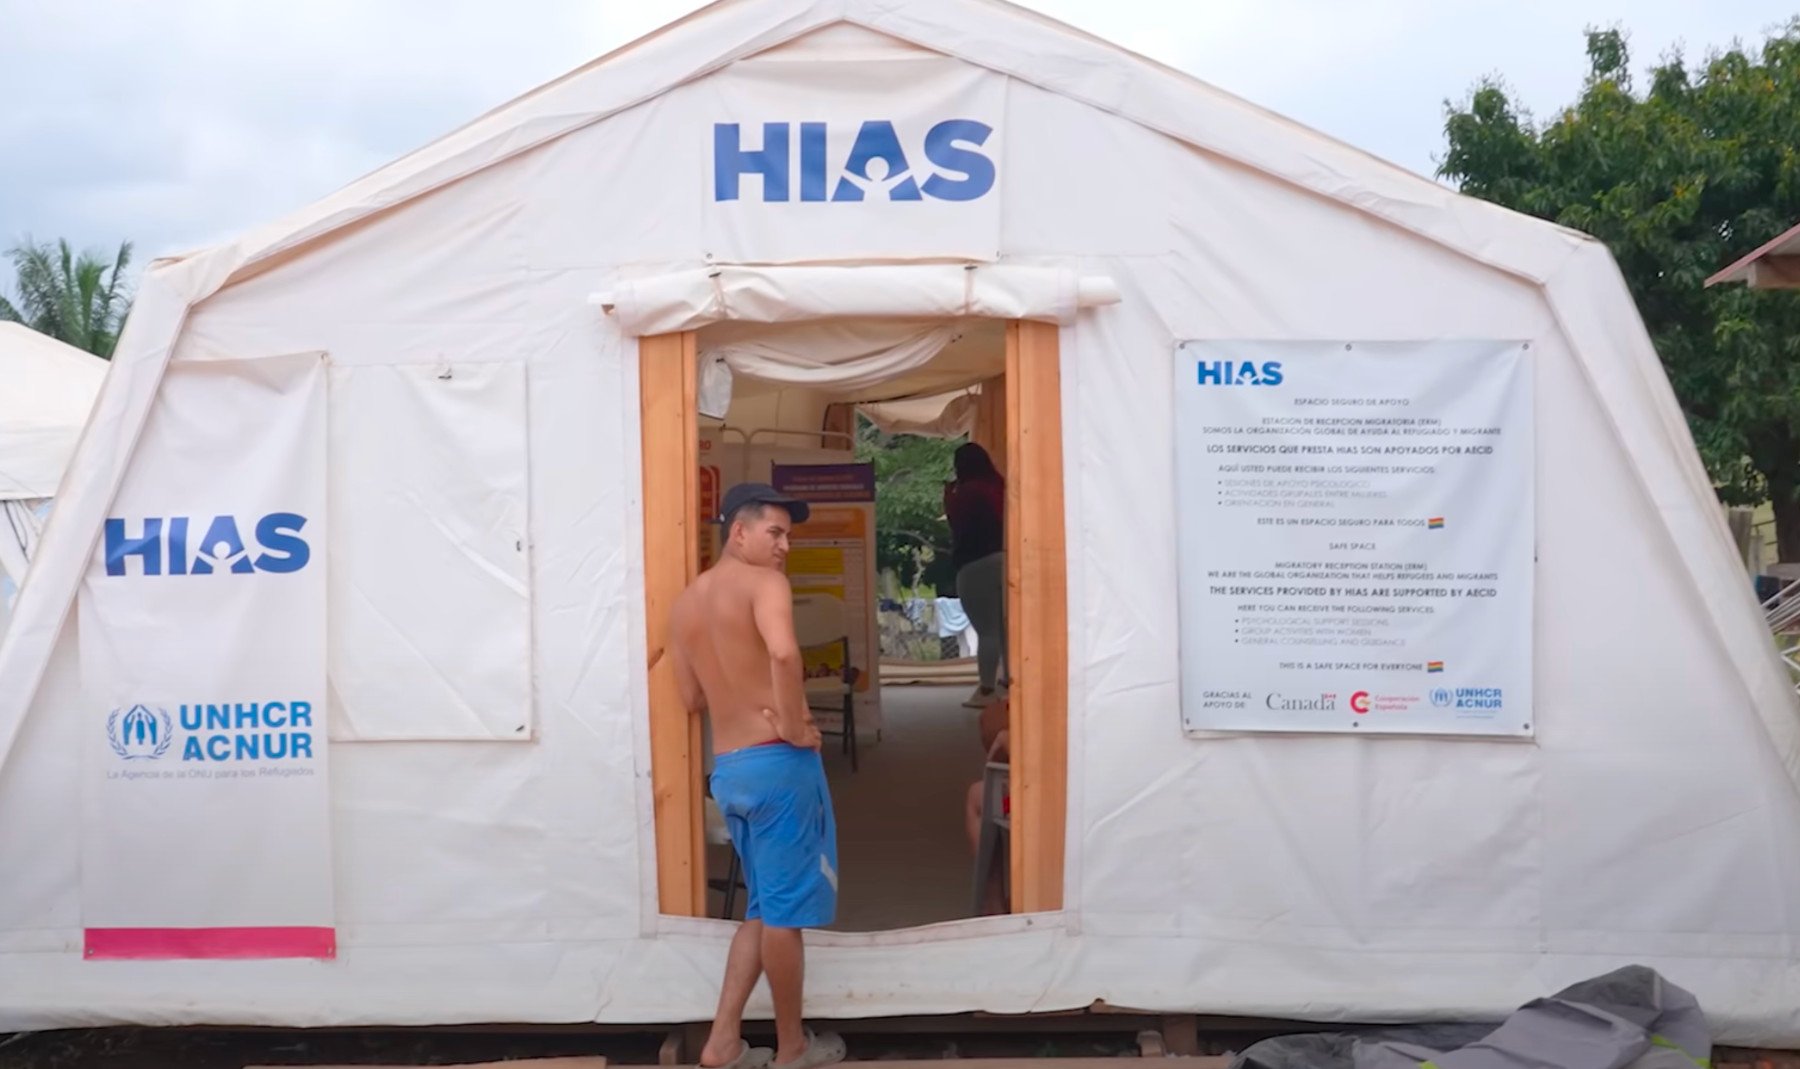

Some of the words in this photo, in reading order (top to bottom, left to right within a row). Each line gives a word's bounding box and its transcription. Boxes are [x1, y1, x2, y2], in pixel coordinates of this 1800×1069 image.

[714, 119, 996, 203] HIAS
[1198, 361, 1283, 386] HIAS
[1294, 398, 1329, 406] ESPACIO
[1331, 398, 1364, 406] SEGURO
[1366, 398, 1376, 406] DE
[1379, 398, 1410, 406] APOYO
[1303, 417, 1314, 425] DE
[1365, 418, 1416, 426] MIGRATORIA
[1203, 426, 1232, 434] SOMOS
[1233, 426, 1243, 434] LA
[1360, 427, 1388, 435] AYUDA
[1391, 427, 1401, 435] AL
[1403, 427, 1450, 435] REFUGIADO
[1207, 445, 1224, 453] LOS
[1226, 445, 1276, 454] SERVICIOS
[1278, 445, 1298, 454] QUE
[1301, 445, 1333, 454] PRESTA
[1336, 445, 1358, 454] HIAS
[1361, 445, 1381, 454] SON
[1384, 446, 1439, 454] APOYADOS
[1441, 446, 1461, 454] POR
[1464, 446, 1493, 455] AECID
[1241, 465, 1265, 473] USTED
[1267, 465, 1292, 473] PUEDE
[1294, 465, 1325, 473] RECIBIR
[1257, 517, 1274, 525] ESTE
[1301, 518, 1336, 526] ESPACIO
[1338, 518, 1371, 526] SEGURO
[1372, 518, 1394, 526] PARA
[1397, 518, 1425, 526] TODOS
[104, 512, 311, 577] HIAS
[1275, 561, 1322, 569] MIGRATORY
[1324, 562, 1368, 570] RECEPTION
[1370, 562, 1403, 570] STATION
[1287, 571, 1349, 579] ORGANIZATION
[1397, 572, 1434, 580] REFUGEES
[1209, 586, 1226, 595] THE
[1229, 586, 1274, 595] SERVICES
[1276, 587, 1327, 596] PROVIDED
[1330, 587, 1342, 596] BY
[1345, 587, 1368, 596] HIAS
[1371, 587, 1390, 596] ARE
[1393, 587, 1448, 597] SUPPORTED
[1450, 588, 1463, 597] BY
[1466, 588, 1497, 597] AECID
[1237, 604, 1256, 612] HERE
[1298, 605, 1329, 613] RECEIVE
[1332, 605, 1345, 613] THE
[1347, 605, 1395, 613] FOLLOWING
[1297, 662, 1304, 670] IS
[1306, 662, 1312, 670] A
[1314, 662, 1333, 670] SAFE
[1381, 663, 1423, 671] EVERYONE
[1203, 691, 1240, 699] GRACIAS
[1455, 688, 1502, 698] UNHCR
[1203, 701, 1233, 709] APOYO
[1265, 692, 1336, 711] Canada
[1455, 698, 1502, 708] ACNUR
[179, 701, 313, 730] UNHCR
[182, 732, 313, 761] ACNUR
[106, 771, 119, 780] La
[162, 769, 174, 780] de
[215, 768, 239, 780] para
[241, 768, 256, 778] los
